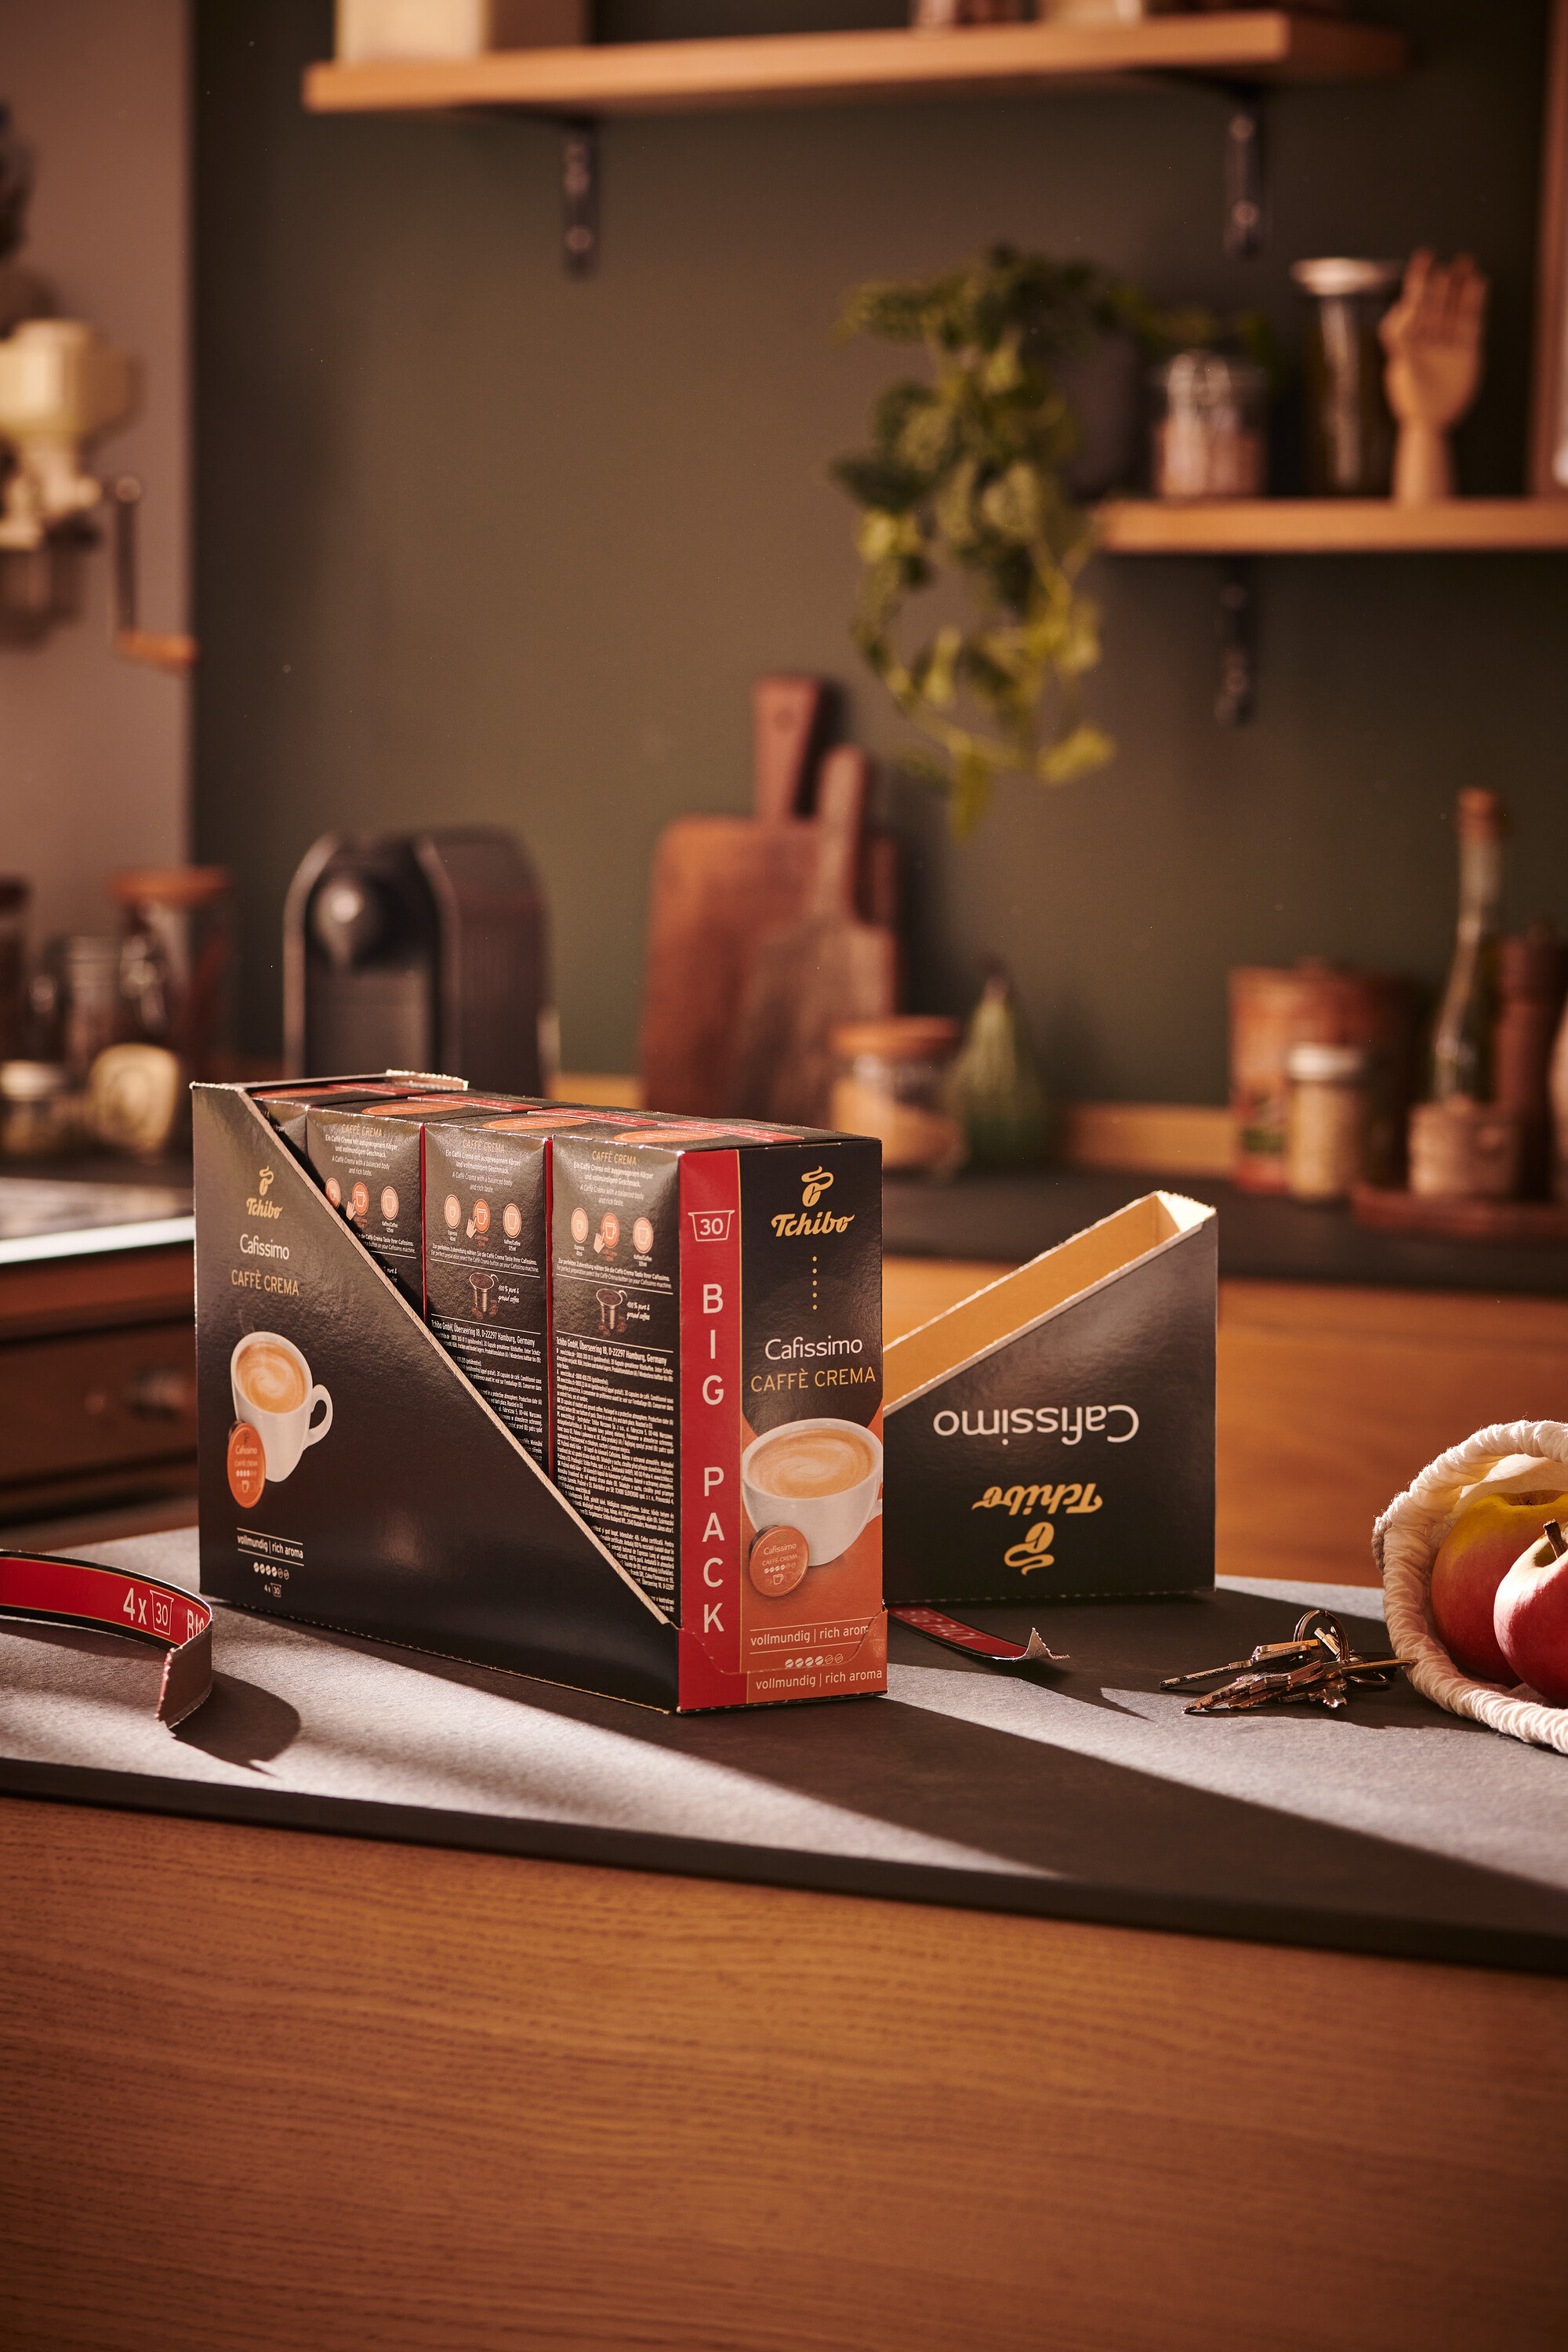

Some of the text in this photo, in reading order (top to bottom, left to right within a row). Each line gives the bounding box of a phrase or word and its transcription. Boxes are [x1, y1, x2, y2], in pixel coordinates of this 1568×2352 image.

[342, 1123, 383, 1137] CAFFÈ CREMA
[463, 1138, 505, 1153] CAFFÈ CREMA
[592, 1151, 637, 1166] CAFFÈ CREMA
[246, 1197, 283, 1219] Tchibo
[699, 1218, 724, 1236] 30
[771, 1210, 855, 1237] Tchibo
[240, 1233, 289, 1260] Cafissimo
[445, 1253, 460, 1261] preparation
[450, 1247, 466, 1255] Zubereitung
[231, 1269, 299, 1296] CAFFÈ CREMA
[431, 1320, 442, 1329] Tchibo
[443, 1322, 453, 1332] GmbH,
[454, 1324, 475, 1336] Überseering
[482, 1329, 497, 1339] D-22297
[497, 1332, 516, 1344] Hamburg,
[517, 1336, 535, 1348] Germany
[702, 1283, 724, 1405] BIG
[557, 1338, 567, 1347] Tchibo
[568, 1339, 579, 1351] GmbH,
[579, 1341, 602, 1355] Überseering
[608, 1347, 626, 1357] D-22297
[626, 1350, 646, 1363] Hamburg,
[647, 1353, 667, 1367] Germany
[765, 1335, 863, 1360] Cafissimo
[751, 1367, 876, 1392] CAFFÈ CREMA
[933, 1405, 1140, 1446] Cafissimo
[971, 1483, 1103, 1515] Tchibo
[237, 1535, 303, 1559] vollmundig rich aroma
[702, 1466, 725, 1633] PACK
[764, 1543, 797, 1555] Cafissimo
[762, 1558, 779, 1566] CAFFÈ
[124, 1588, 168, 1626] 4x 30
[751, 1631, 810, 1646] vollmundig
[820, 1628, 840, 1639] rich
[756, 1670, 882, 1690] vollmundig rich aroma
